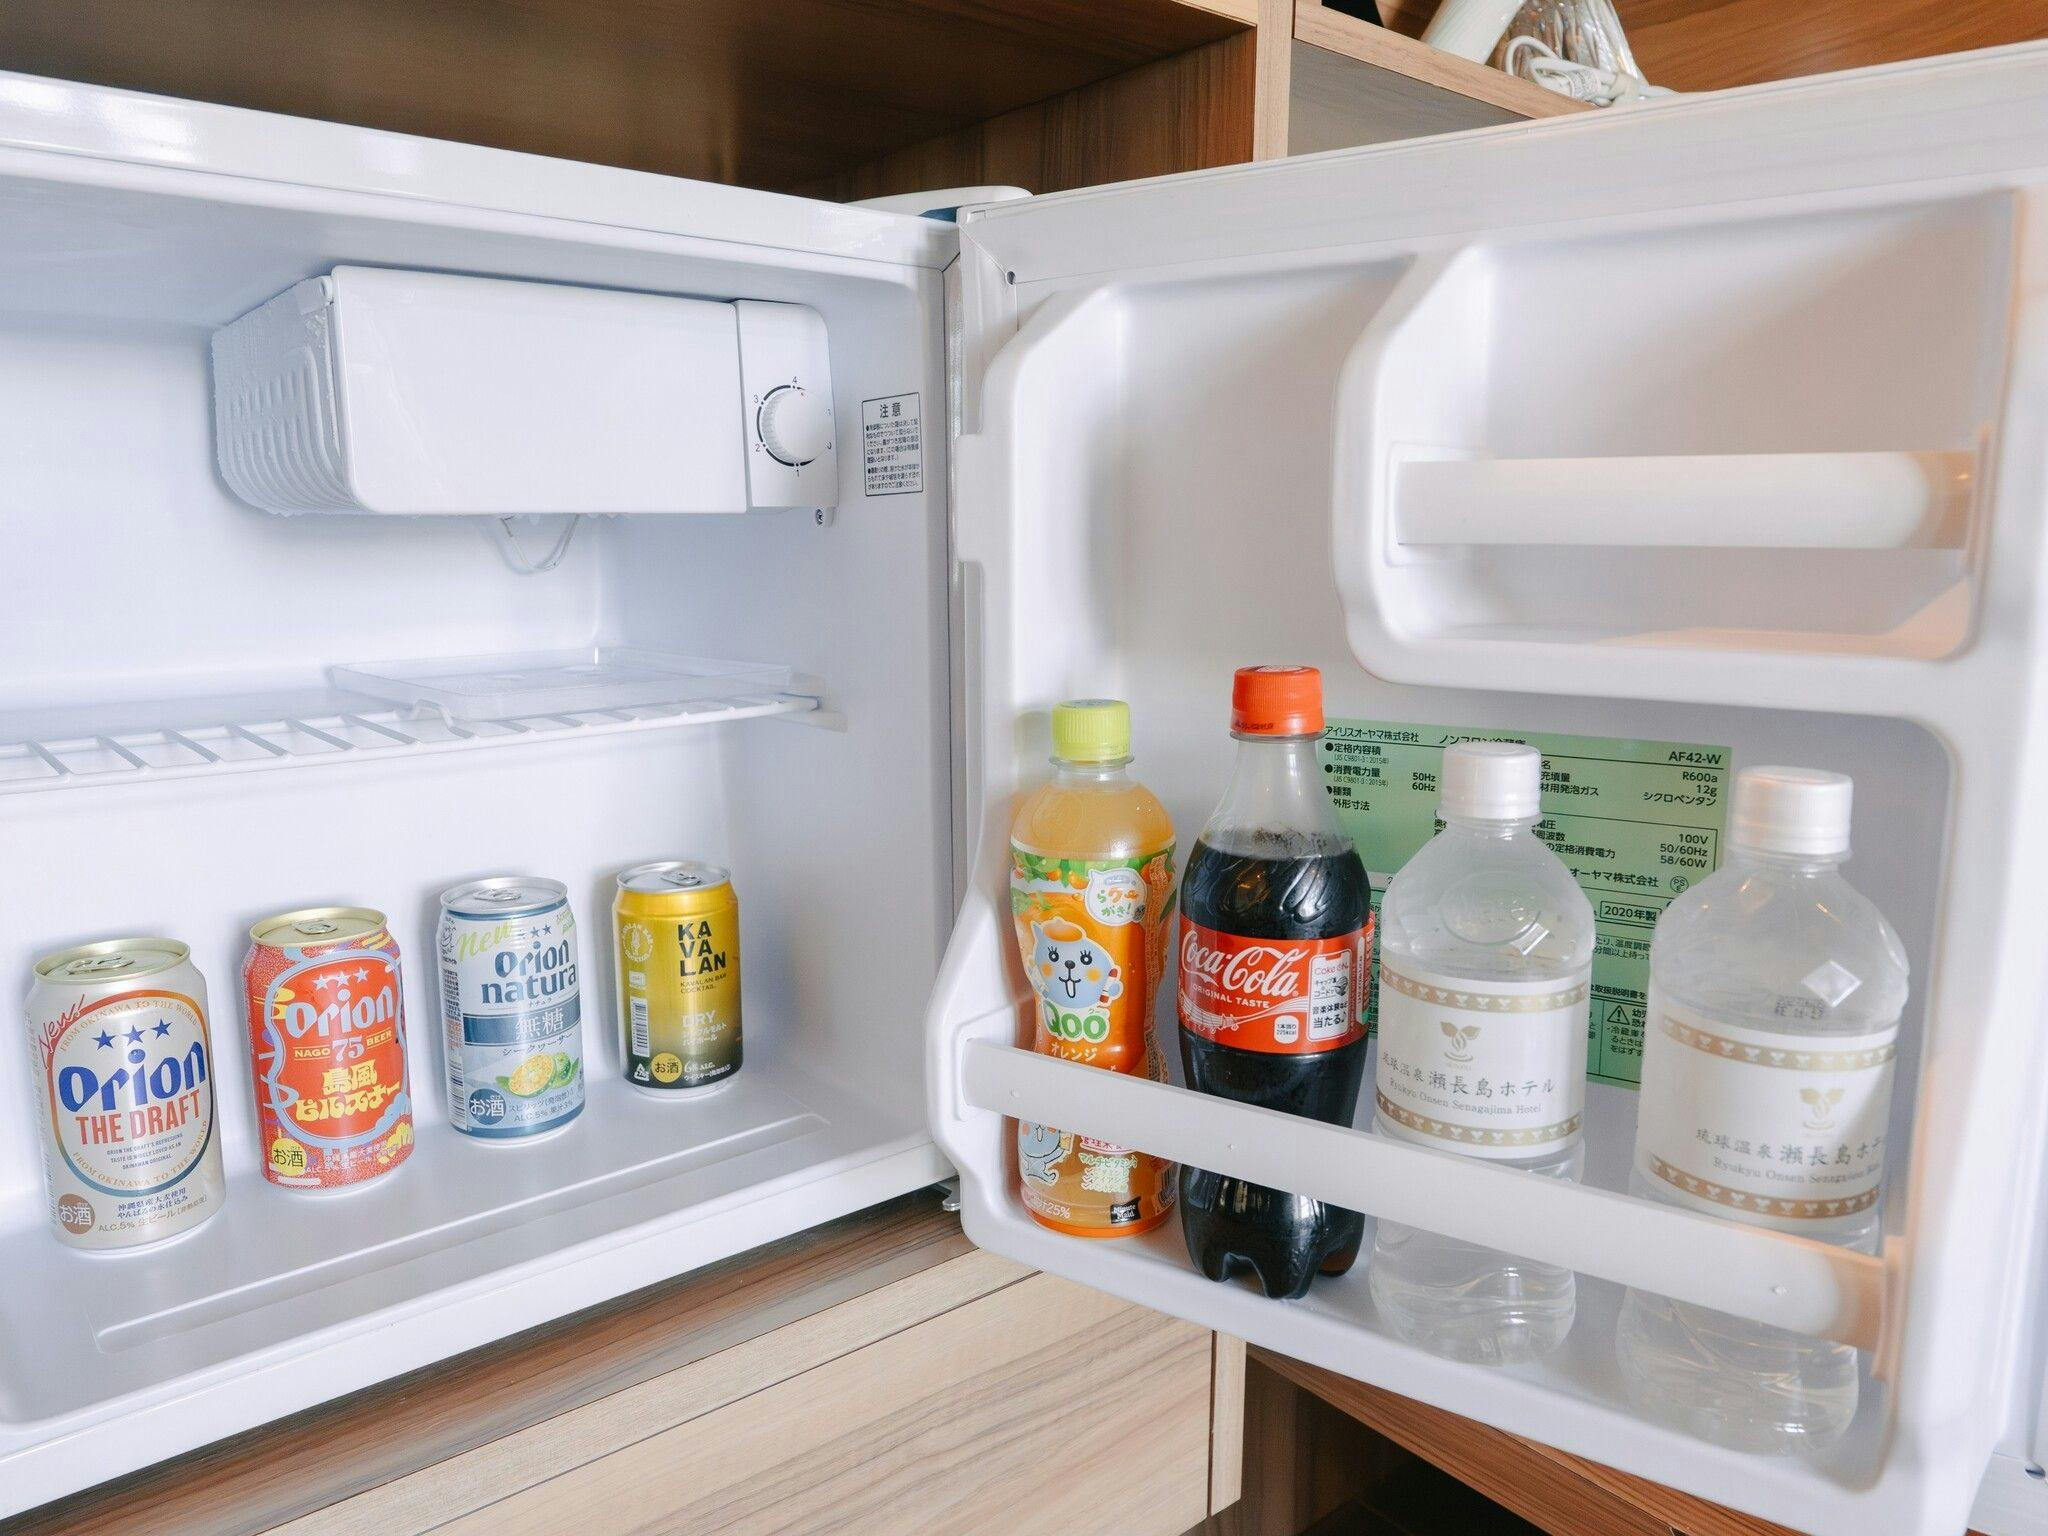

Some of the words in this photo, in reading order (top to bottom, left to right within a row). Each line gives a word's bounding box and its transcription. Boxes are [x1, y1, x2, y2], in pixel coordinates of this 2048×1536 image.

[879, 402, 901, 418] 注意
[1326, 726, 1419, 743] アイリスオーヤマ株式会社
[1333, 742, 1381, 756] 定格内容積
[1668, 751, 1722, 765] AF42-W
[1333, 764, 1381, 778] 消費電力量
[1412, 772, 1436, 782] 50Hz
[1682, 771, 1718, 783] R600a
[1333, 785, 1352, 797] 種類
[1411, 782, 1436, 792] 60Hz
[1696, 784, 1718, 797] 12g
[1643, 791, 1717, 807] シクロペンタン
[1678, 833, 1709, 845] 100V
[1660, 843, 1708, 857] 50/60Hz
[1660, 855, 1708, 869] 58/60W
[1604, 905, 1657, 922] 2020年製
[677, 920, 712, 941] KA
[678, 938, 713, 959] VA
[679, 951, 727, 977] LAN
[480, 963, 577, 1004] natura
[1192, 983, 1232, 1003] ORIGINAL
[1235, 996, 1270, 1008] TASTE
[293, 1047, 331, 1058] NAGO
[331, 1036, 365, 1063] 75
[366, 1029, 392, 1047] BEER
[1051, 1041, 1098, 1062] オレンジ
[654, 1061, 679, 1075] お酒
[470, 1096, 505, 1117] お酒
[1451, 1099, 1512, 1116] Senagajima
[1516, 1103, 1541, 1114] Hotel
[76, 1113, 125, 1146] THE
[130, 1089, 201, 1140] DRAFT
[273, 1148, 304, 1168] お酒
[1713, 1156, 1761, 1179] Ryukyu
[1765, 1169, 1805, 1184] Onsen
[59, 1204, 93, 1226] お酒
